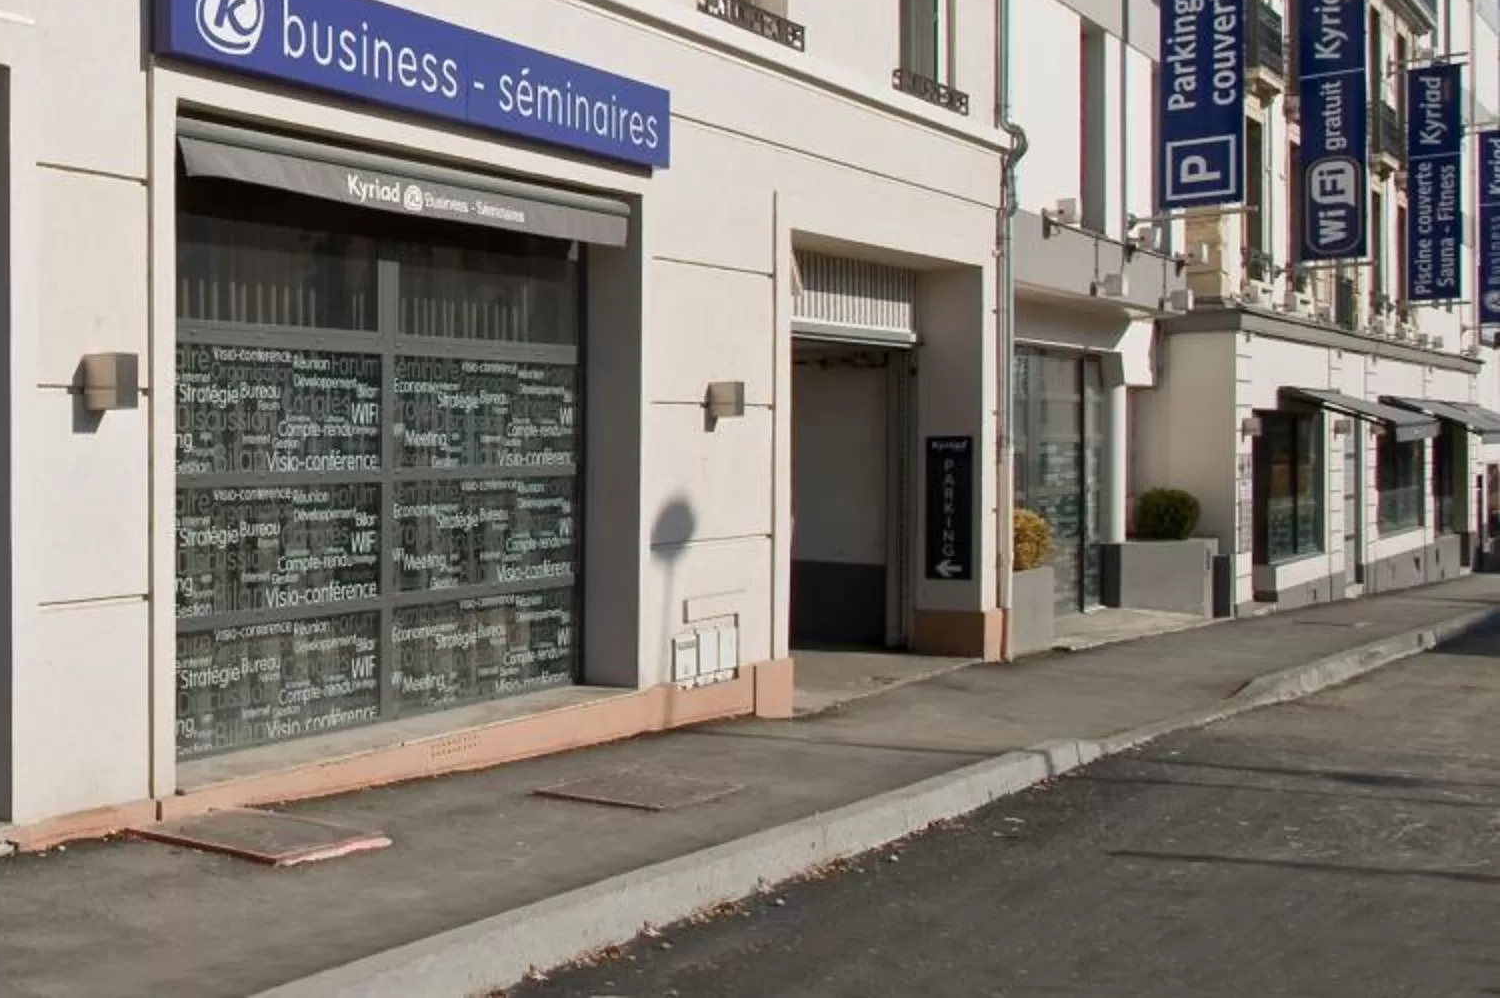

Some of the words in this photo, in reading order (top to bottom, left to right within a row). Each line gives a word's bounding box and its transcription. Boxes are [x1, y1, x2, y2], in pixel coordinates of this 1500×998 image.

[499, 68, 659, 149] séminaires
[1318, 81, 1347, 151] gratuit
[1419, 77, 1448, 145] Kyriad
[347, 173, 400, 203] Kyriad
[1416, 162, 1433, 233] couverte
[1437, 164, 1456, 221] Fitness
[1415, 239, 1433, 294] Piscine
[1437, 237, 1455, 287] Sauna
